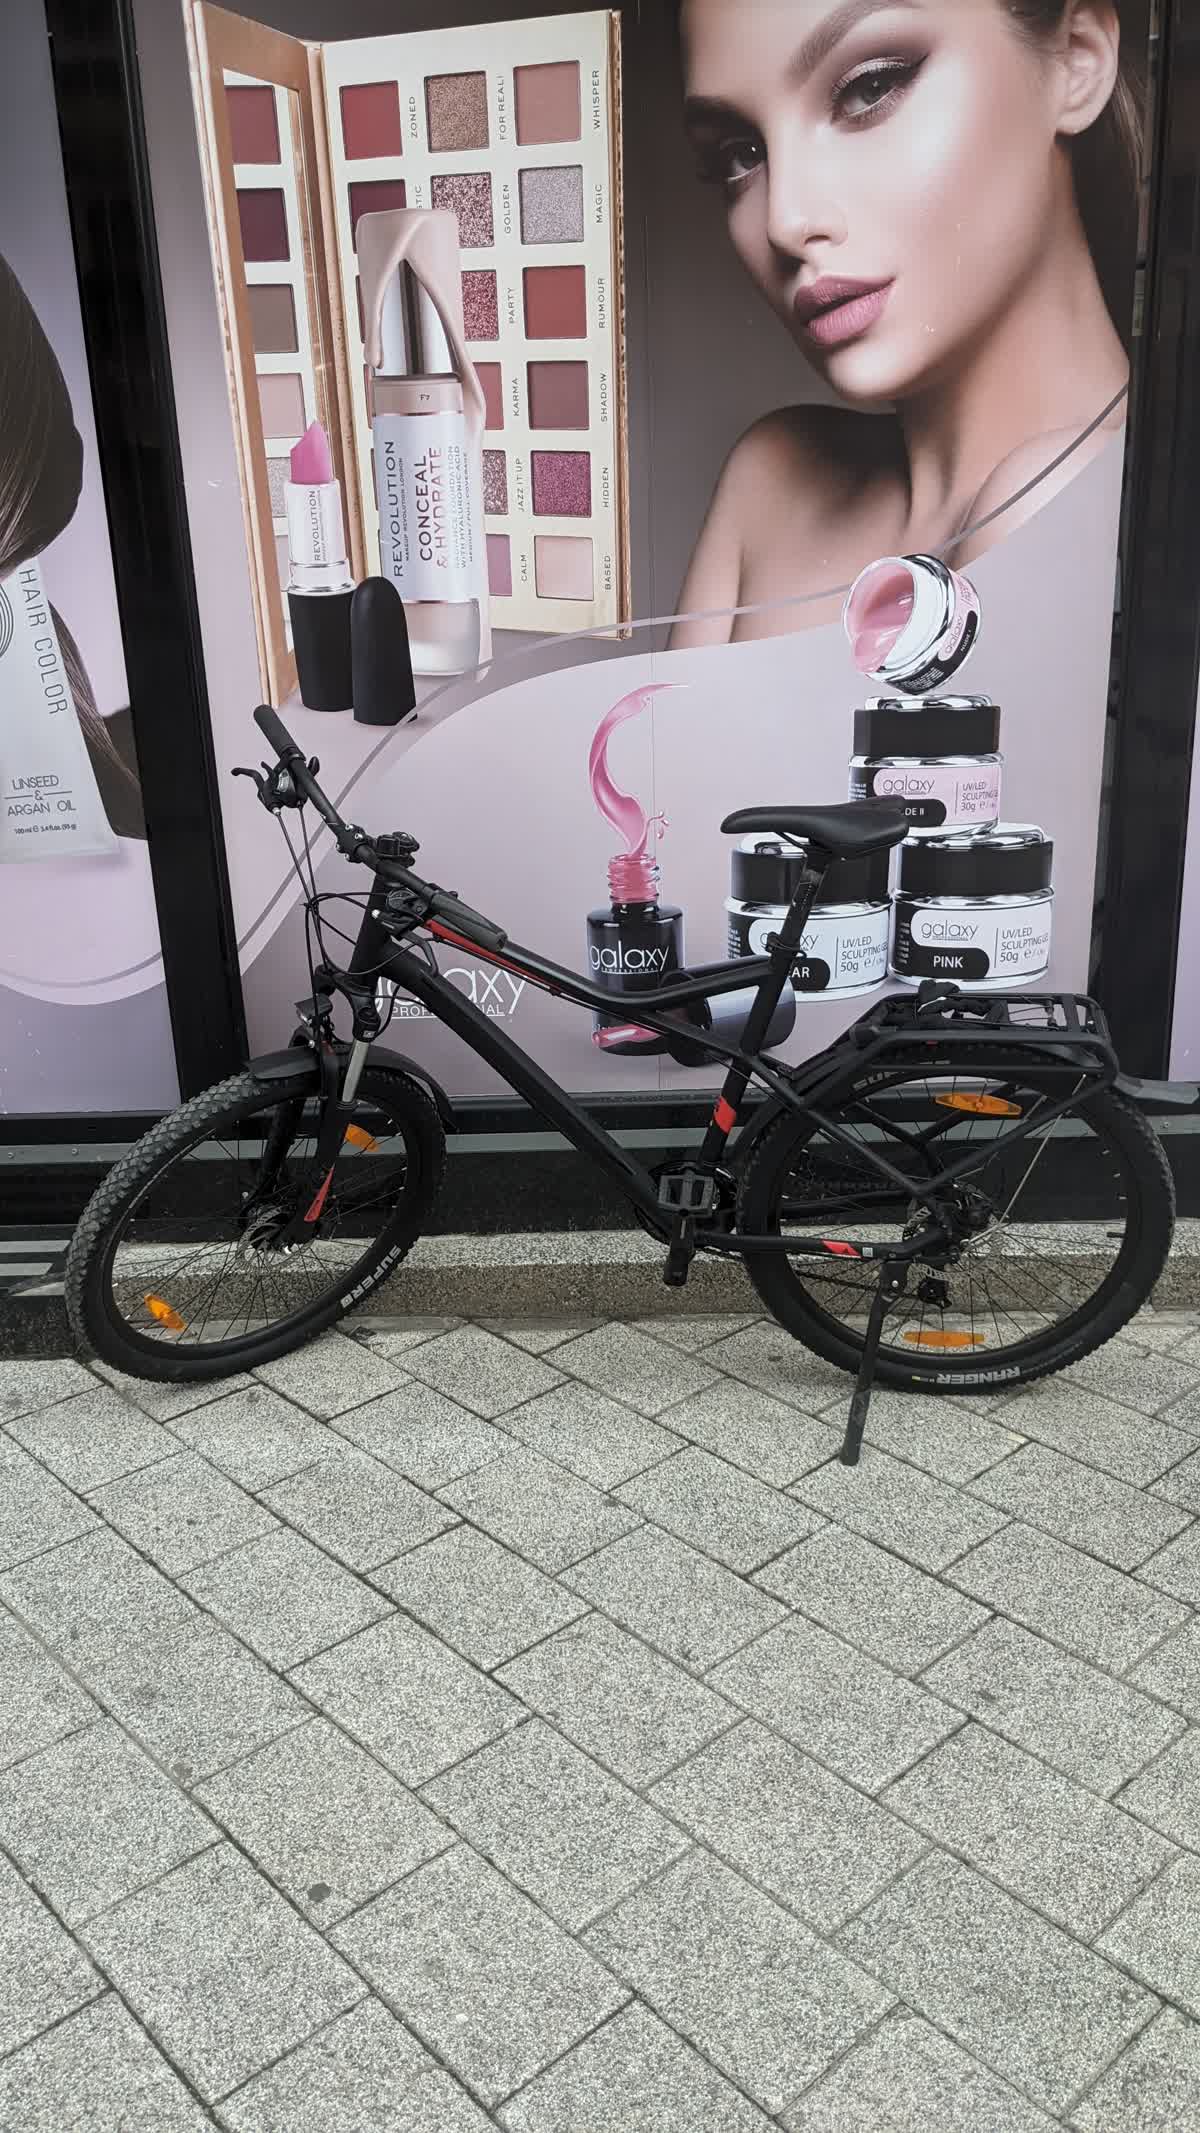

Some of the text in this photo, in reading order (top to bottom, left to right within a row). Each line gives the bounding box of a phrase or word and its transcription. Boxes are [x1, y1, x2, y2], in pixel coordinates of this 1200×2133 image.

[591, 69, 601, 130] WHISPER
[408, 96, 418, 138] ZONED
[414, 184, 423, 209] STIC
[594, 184, 604, 224] MAGIC
[500, 184, 511, 234] GOLDEN
[507, 287, 516, 325] PARTY
[597, 277, 606, 329] RUMOUR
[420, 393, 431, 401] F7
[511, 377, 520, 417] KARMA
[600, 372, 608, 423] SHADOW
[453, 446, 462, 473] ACID
[515, 458, 524, 473] UP
[601, 467, 609, 508] HIDDEN
[384, 441, 403, 577] REVOLUTION
[414, 455, 433, 561] CONCEAL
[515, 488, 525, 513] JAZZ
[308, 490, 321, 561] REVOLUTION
[519, 554, 528, 582] CALM
[603, 555, 612, 590] BASED
[18, 568, 69, 715] HAIR COLOR
[12, 774, 59, 790] LINSEED
[882, 776, 935, 794] galaxy
[962, 782, 986, 791] UV/LED
[961, 790, 993, 801] SCULPTING
[7, 799, 77, 816] ARGAN OIL
[904, 808, 917, 816] DE
[960, 802, 976, 812] 30g
[921, 920, 979, 939] galaxy
[1001, 927, 1033, 939] UV/LED
[841, 945, 881, 961] SCULPTING
[842, 936, 871, 949] UV/LED
[1000, 936, 1042, 951] SCULPTING
[589, 940, 670, 971] galaxy
[840, 960, 859, 973] 50g
[933, 955, 964, 968] PINK
[1000, 951, 1019, 964] 50g
[789, 966, 810, 978] AR
[936, 1365, 1022, 1385] RANGER
